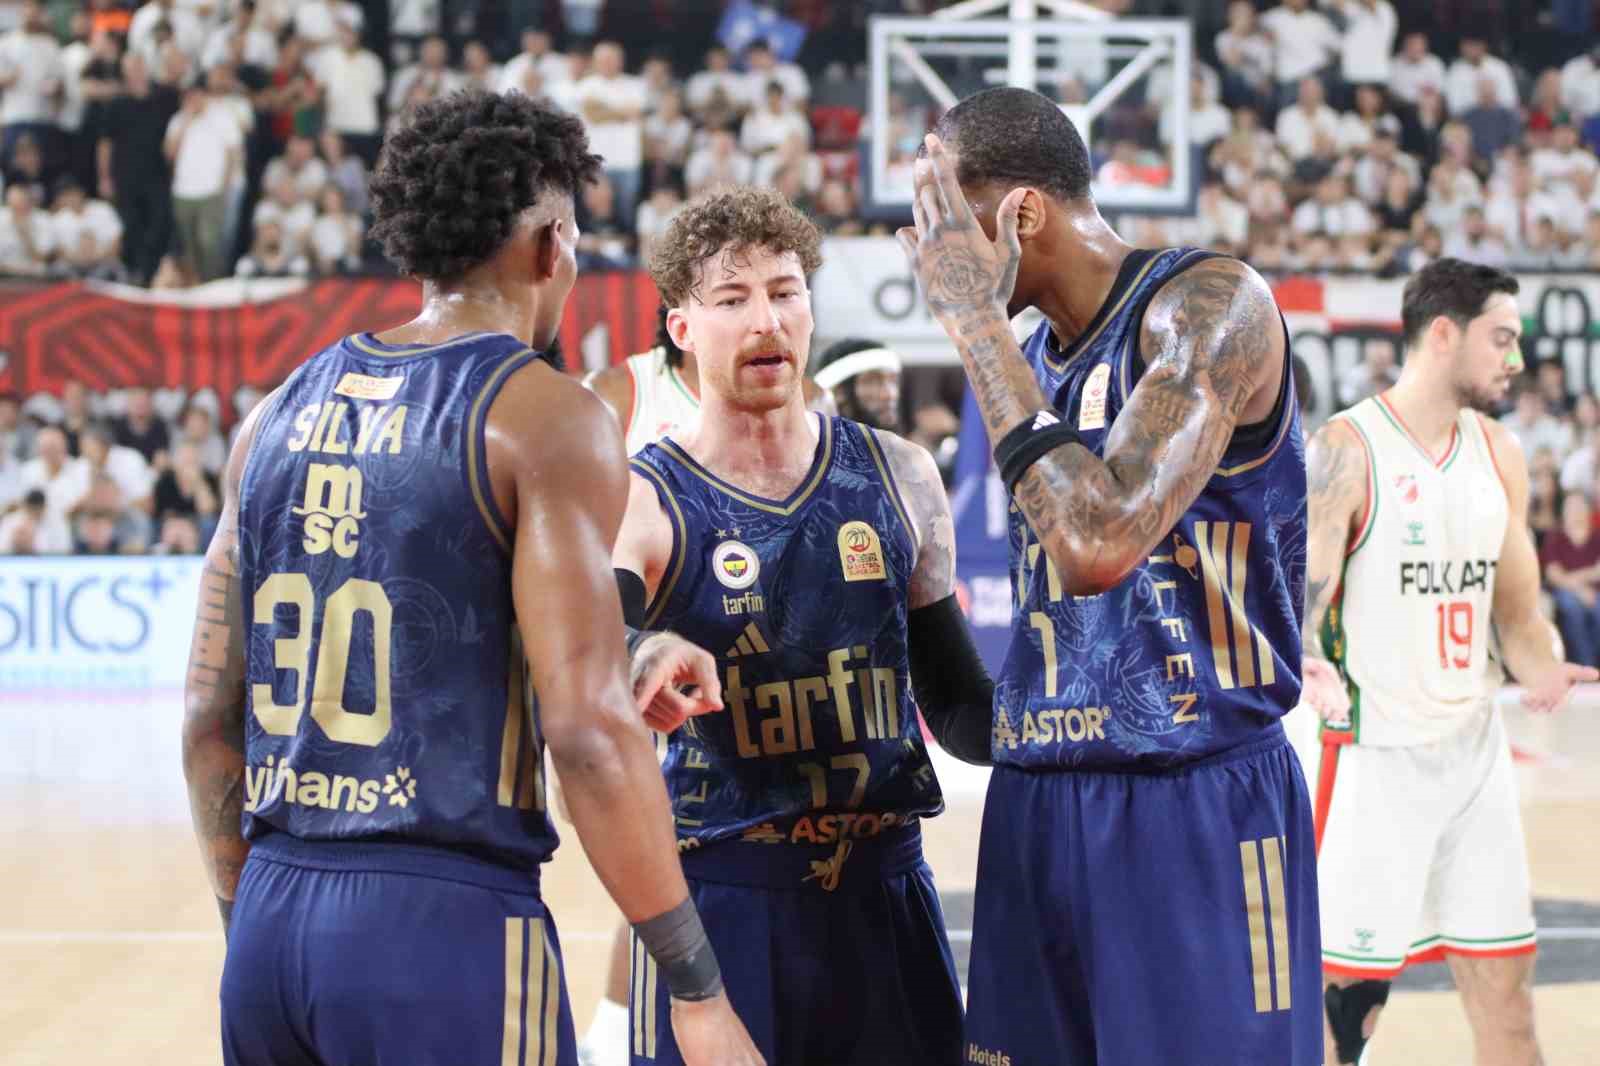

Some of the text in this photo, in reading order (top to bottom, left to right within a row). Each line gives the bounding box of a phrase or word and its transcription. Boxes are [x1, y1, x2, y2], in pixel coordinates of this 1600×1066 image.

[287, 400, 408, 455] SILVA
[722, 591, 764, 616] tarfin
[252, 573, 393, 747] 30
[1437, 601, 1473, 671] 19
[722, 645, 899, 759] tarfin
[799, 752, 871, 810] 17
[968, 1043, 1010, 1066] Hotels
